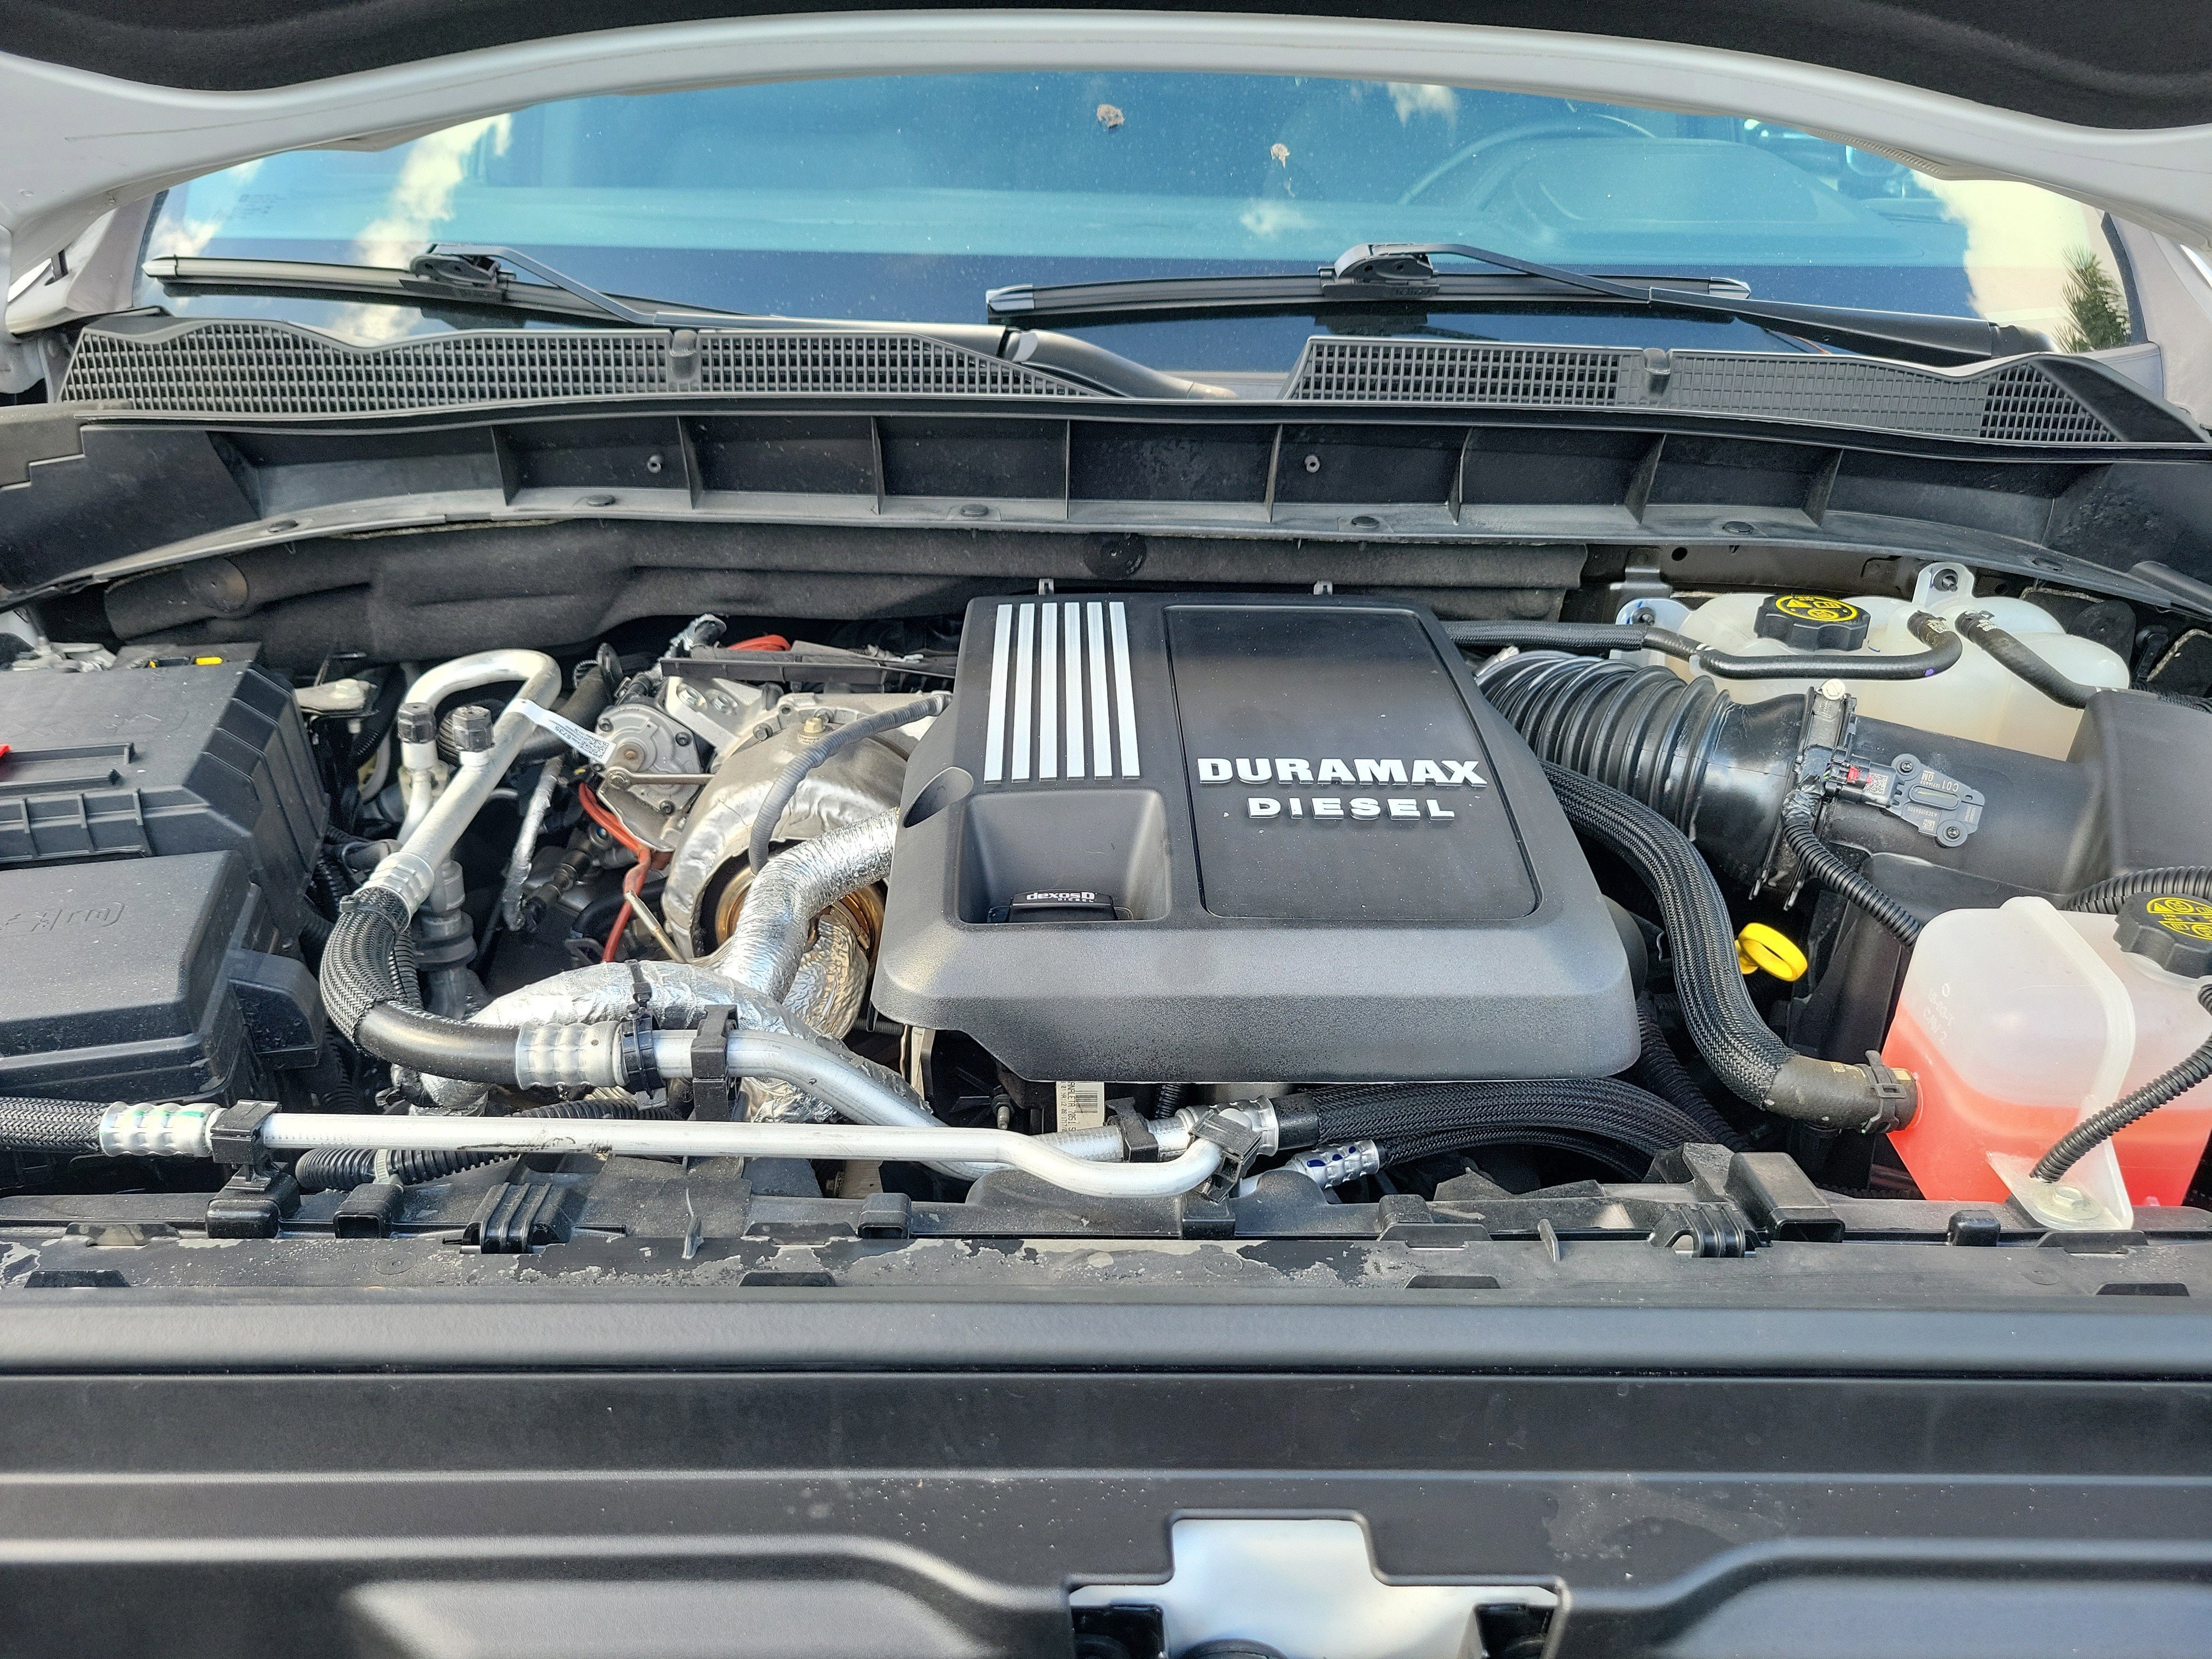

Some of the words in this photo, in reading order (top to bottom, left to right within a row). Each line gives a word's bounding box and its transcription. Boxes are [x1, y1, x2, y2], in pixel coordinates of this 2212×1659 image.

[1196, 758, 1487, 788] DURAMAX
[1921, 772, 1934, 782] GM
[1942, 780, 1959, 792] C01
[1246, 797, 1455, 821] DIESEL
[387, 1000, 439, 1020] GALAXY
